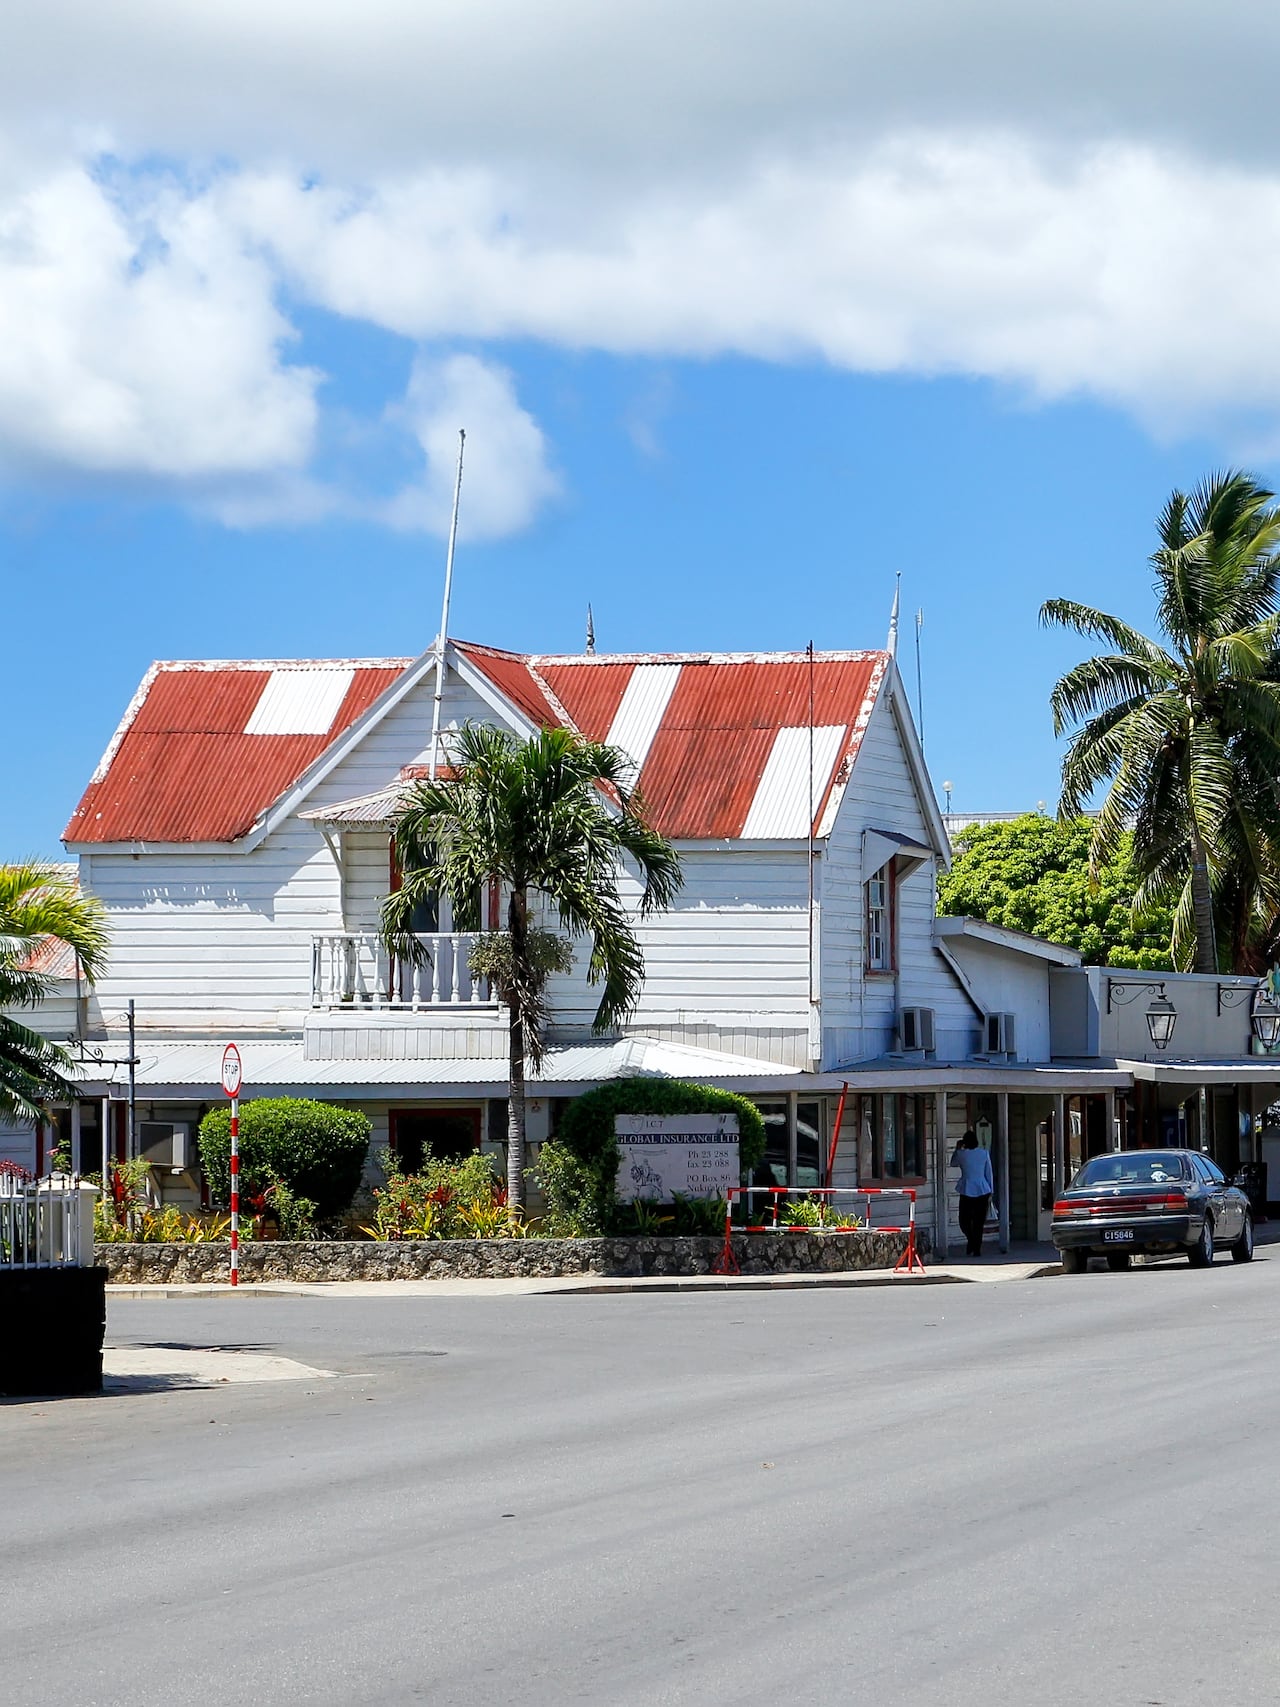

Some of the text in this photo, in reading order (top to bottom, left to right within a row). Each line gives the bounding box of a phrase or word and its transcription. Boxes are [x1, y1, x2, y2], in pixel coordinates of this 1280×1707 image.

[225, 1064, 239, 1075] STOP
[616, 1133, 740, 1144] GLOBAL INSURANCE LTD
[701, 1150, 711, 1159] 23
[702, 1174, 718, 1183] Box
